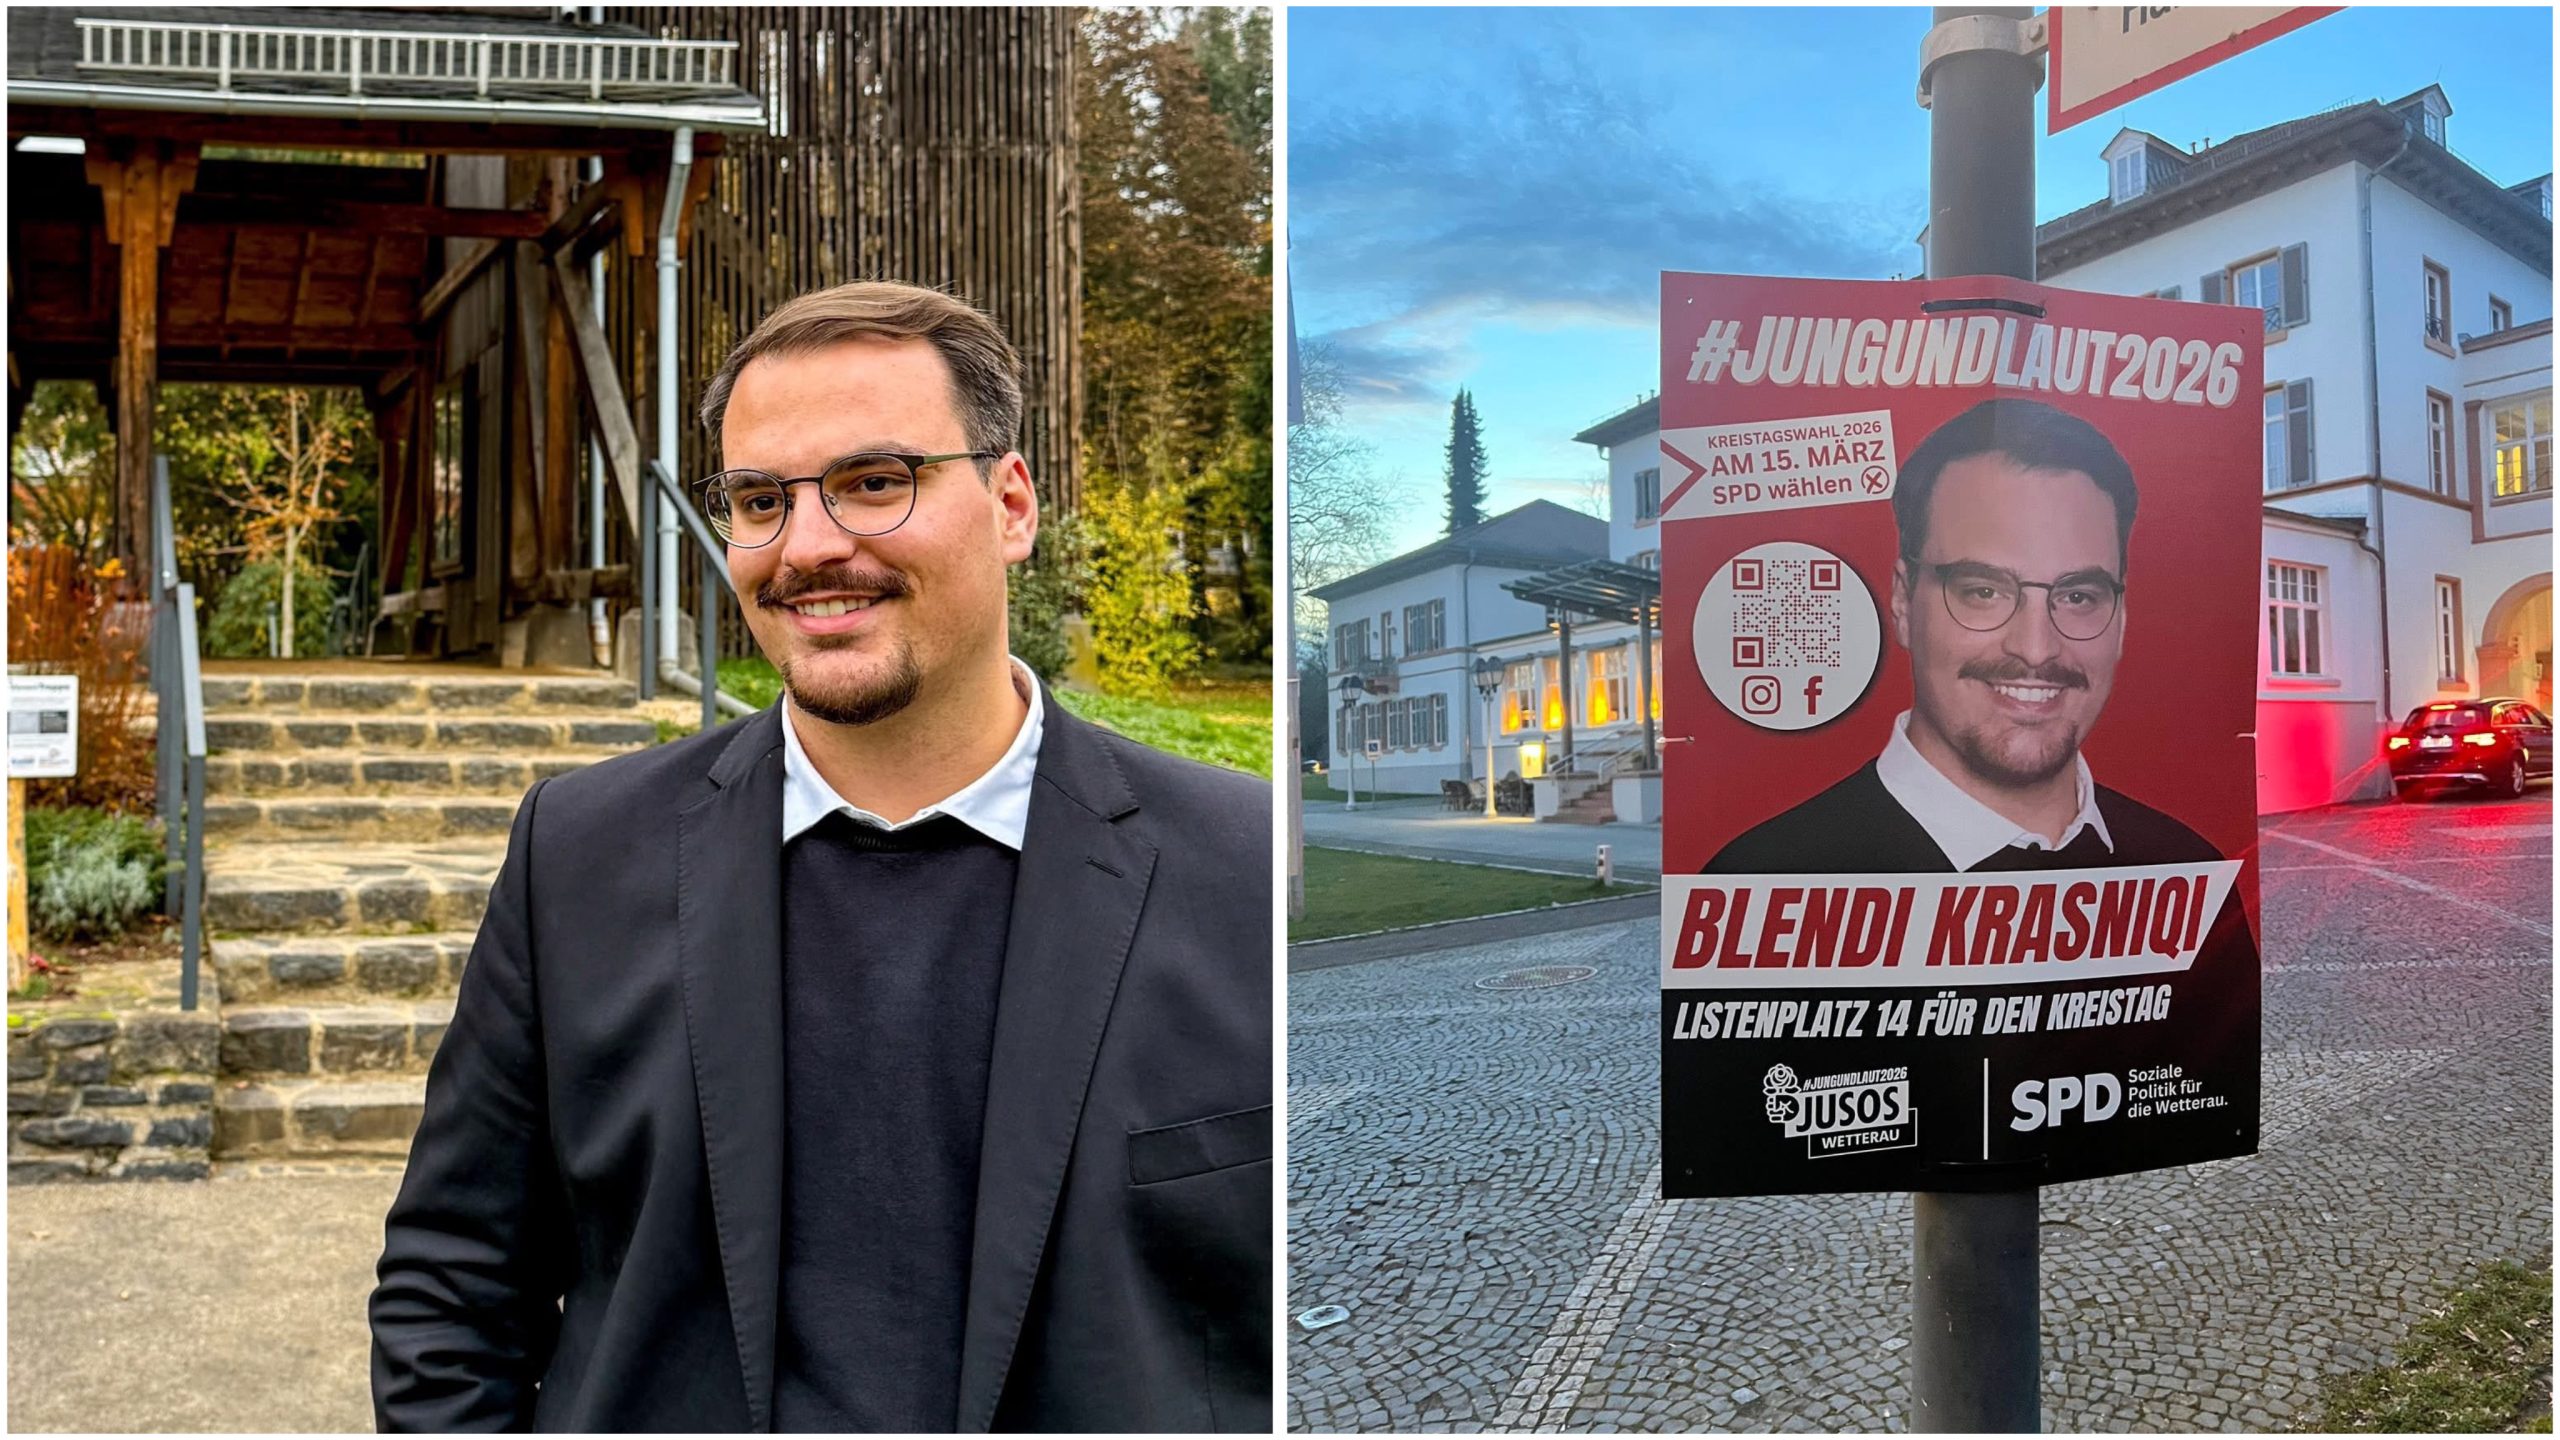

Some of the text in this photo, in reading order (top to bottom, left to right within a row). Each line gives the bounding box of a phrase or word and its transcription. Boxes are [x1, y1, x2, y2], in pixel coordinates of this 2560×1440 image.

[1686, 315, 2244, 406] #JUNGUNDLAUT2026
[1708, 421, 1882, 449] KREISTAGSWAHL 2026
[1711, 439, 1885, 477] AM 15. MÄRZ
[1712, 475, 1852, 505] SPD wählen
[1672, 875, 2209, 969] BLENDI KRASNIQI
[1673, 984, 2172, 1039] LISTENPLATZ 14 FÜR DEN KREISTAG
[1803, 1066, 1908, 1092] #JUNGUNDLAUT2026
[2128, 1064, 2183, 1083] Soziale
[2010, 1072, 2122, 1132] SPD
[2128, 1079, 2203, 1102] Politik für
[1796, 1086, 1900, 1133] JUSOS
[2127, 1095, 2229, 1119] die Wetterau.
[1821, 1128, 1900, 1149] WETTERAU
